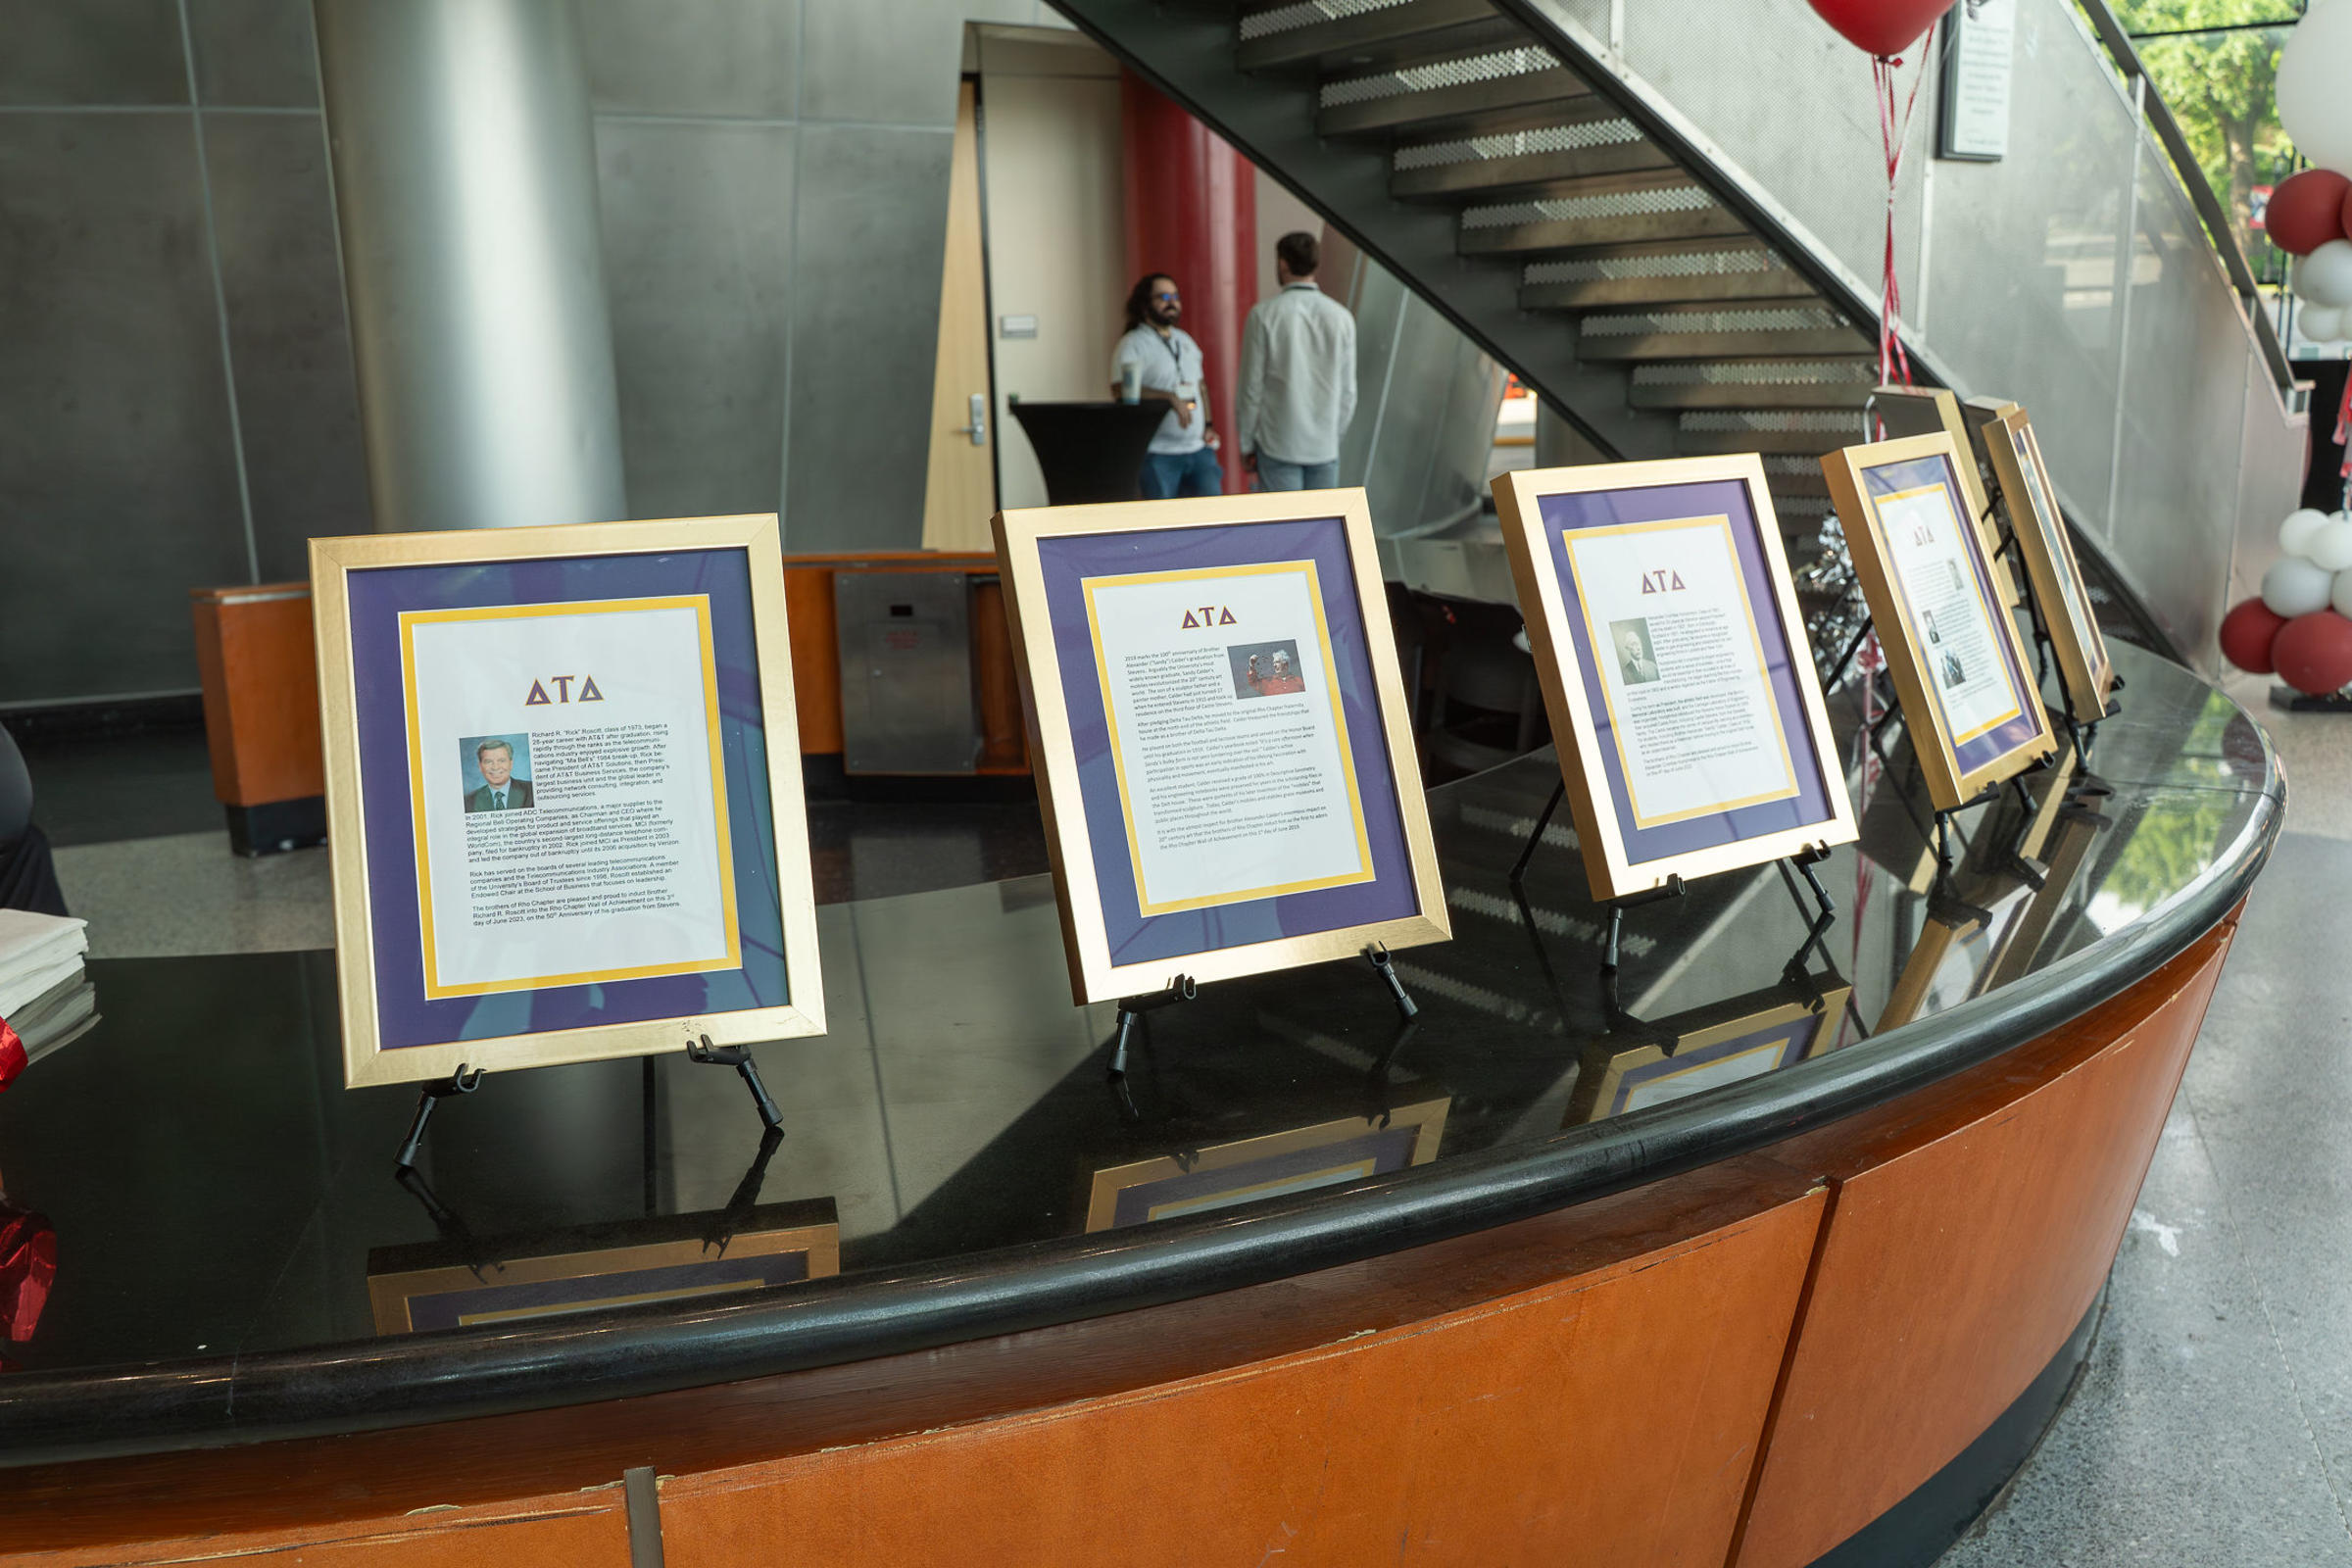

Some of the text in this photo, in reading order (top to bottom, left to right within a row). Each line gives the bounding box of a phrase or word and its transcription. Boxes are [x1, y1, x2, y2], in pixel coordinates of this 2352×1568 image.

[644, 722, 662, 730] began
[532, 744, 552, 752] rapidly
[553, 743, 575, 751] through
[622, 736, 660, 745] telecommuni-
[502, 852, 529, 861] company
[547, 847, 579, 857] bankruptcy
[617, 841, 648, 850] acquisition
[587, 858, 608, 867] leading
[609, 853, 665, 864] telecommunications
[469, 875, 502, 885] companies
[526, 867, 585, 879] Telecommunications
[586, 865, 609, 874] Industry
[488, 881, 522, 891] University's
[549, 876, 574, 884] Trustees
[630, 867, 663, 876] established
[471, 890, 499, 898] Endowed
[563, 881, 589, 889] Business
[472, 910, 495, 918] Richard
[562, 902, 586, 911] Chapter
[608, 896, 645, 905] Achievement
[485, 902, 509, 910] brothers
[531, 897, 554, 906] Chapter
[566, 894, 590, 903] pleased
[603, 891, 620, 900] proud
[472, 919, 484, 927] day
[558, 908, 592, 918] Anniversary
[610, 903, 641, 913] graduation
